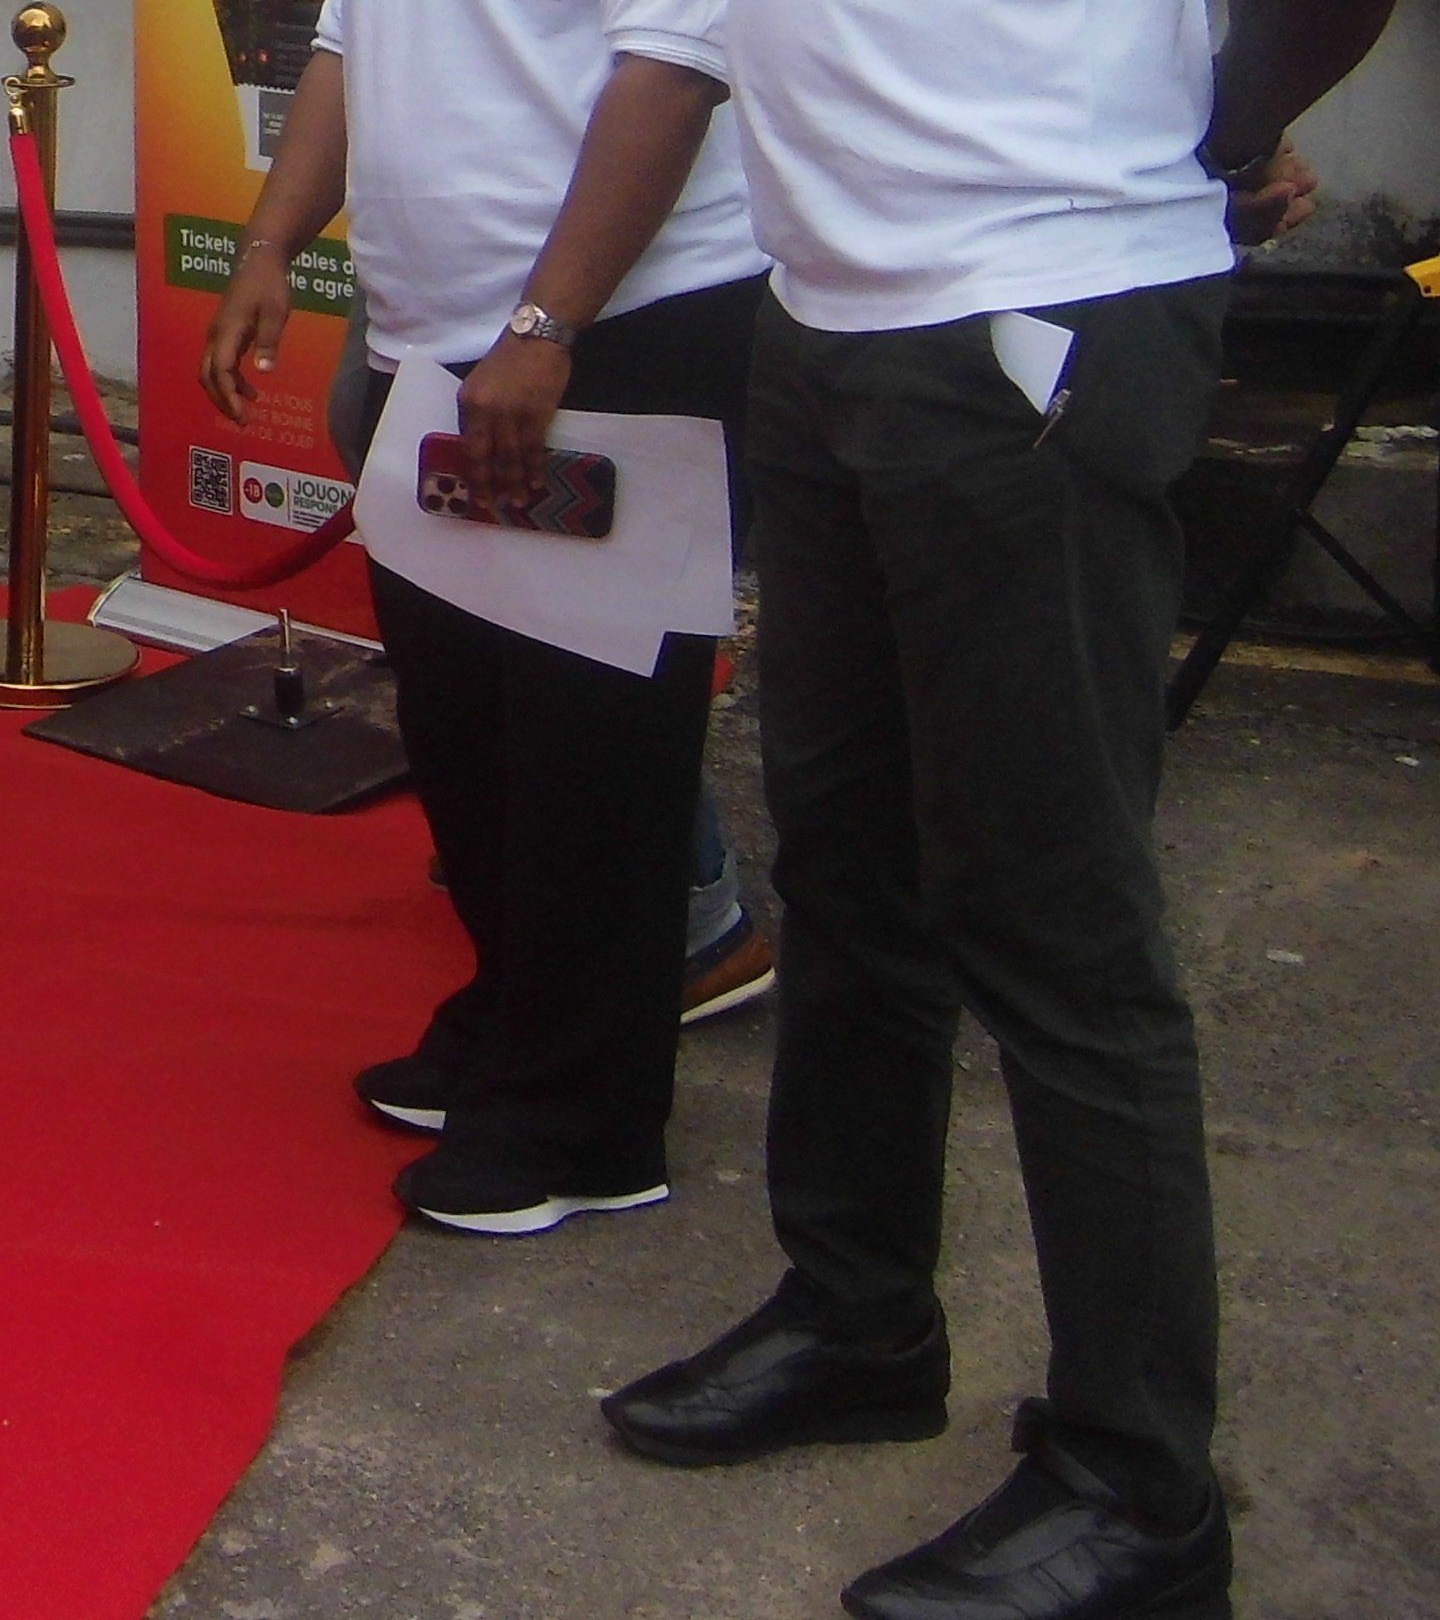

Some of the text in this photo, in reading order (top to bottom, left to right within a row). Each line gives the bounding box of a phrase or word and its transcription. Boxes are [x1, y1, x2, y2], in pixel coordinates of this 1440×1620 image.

[180, 228, 236, 255] Tickets
[180, 254, 232, 277] points
[312, 278, 355, 301] agré
